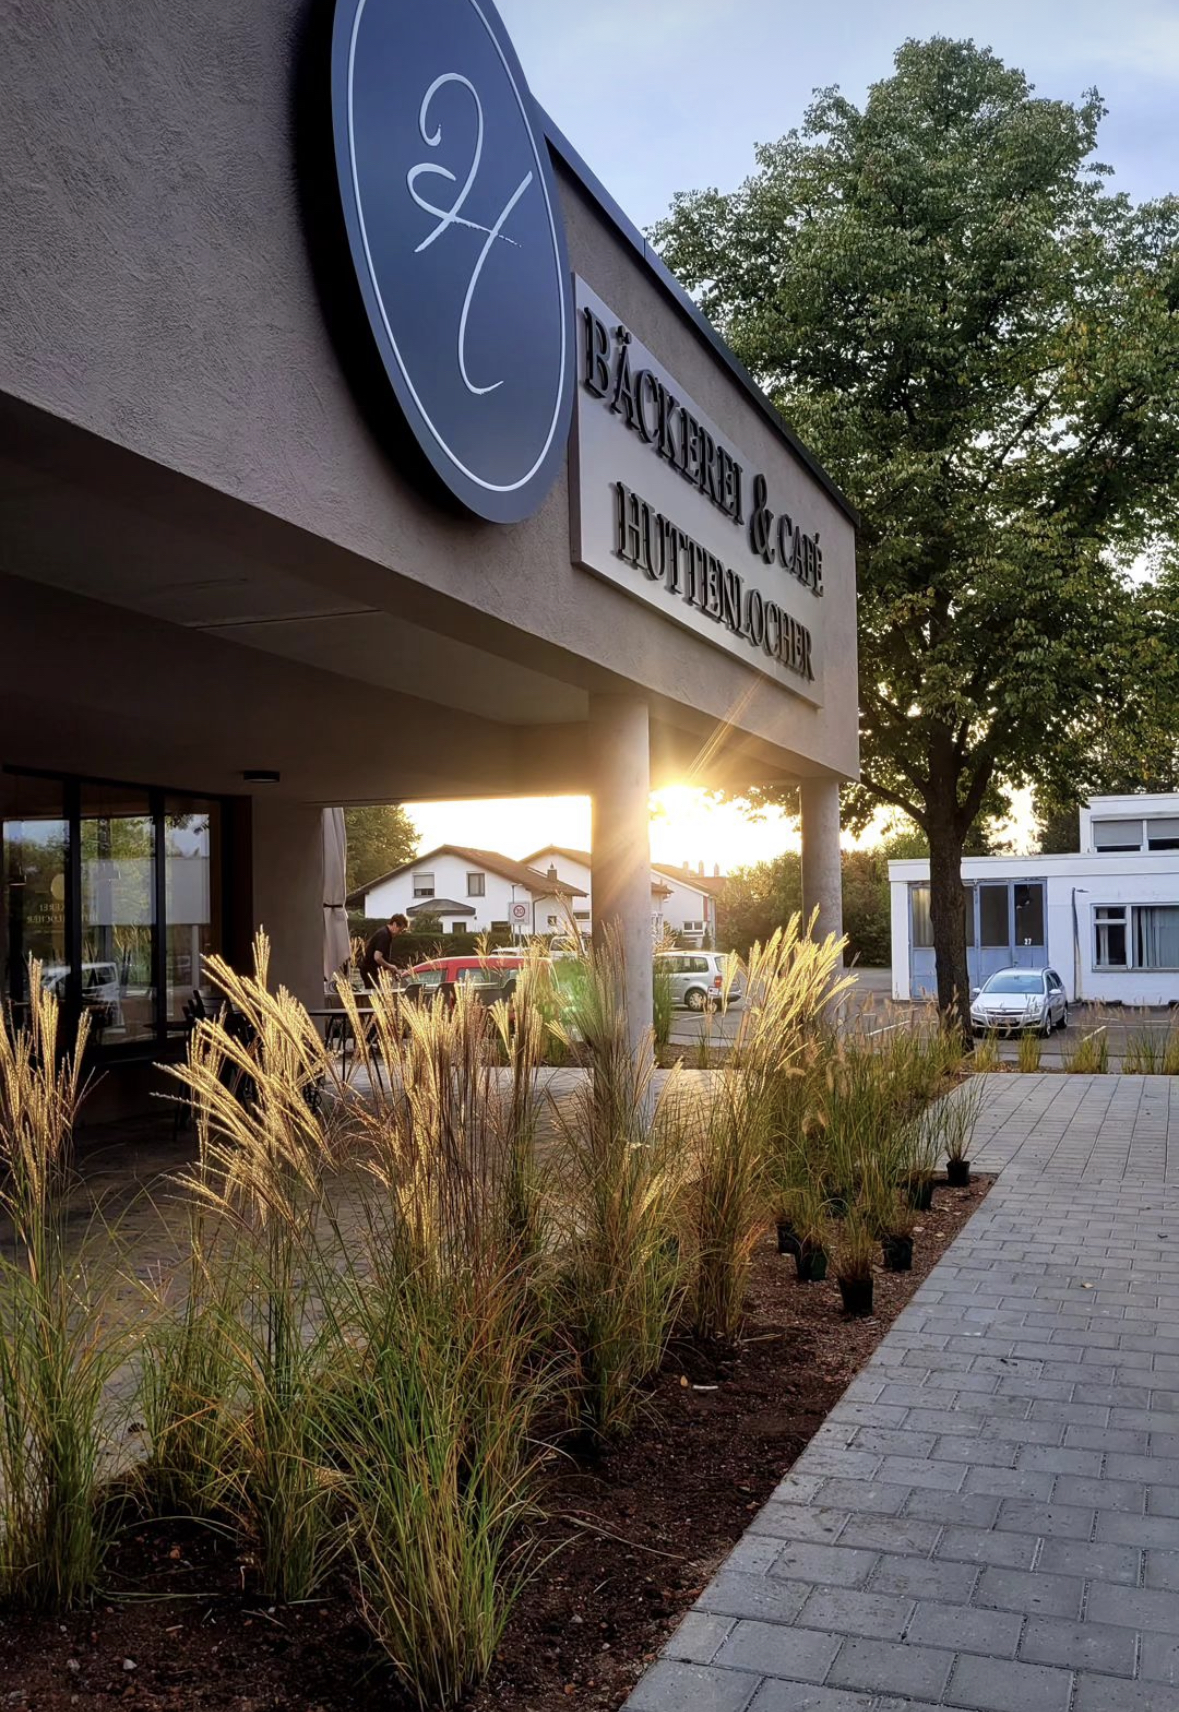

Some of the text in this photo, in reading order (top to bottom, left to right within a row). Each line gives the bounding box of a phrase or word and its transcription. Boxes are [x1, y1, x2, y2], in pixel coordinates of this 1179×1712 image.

[584, 307, 825, 598] BÄCKEREI & CAFÉ
[615, 481, 815, 682] HUTTENLOCHER
